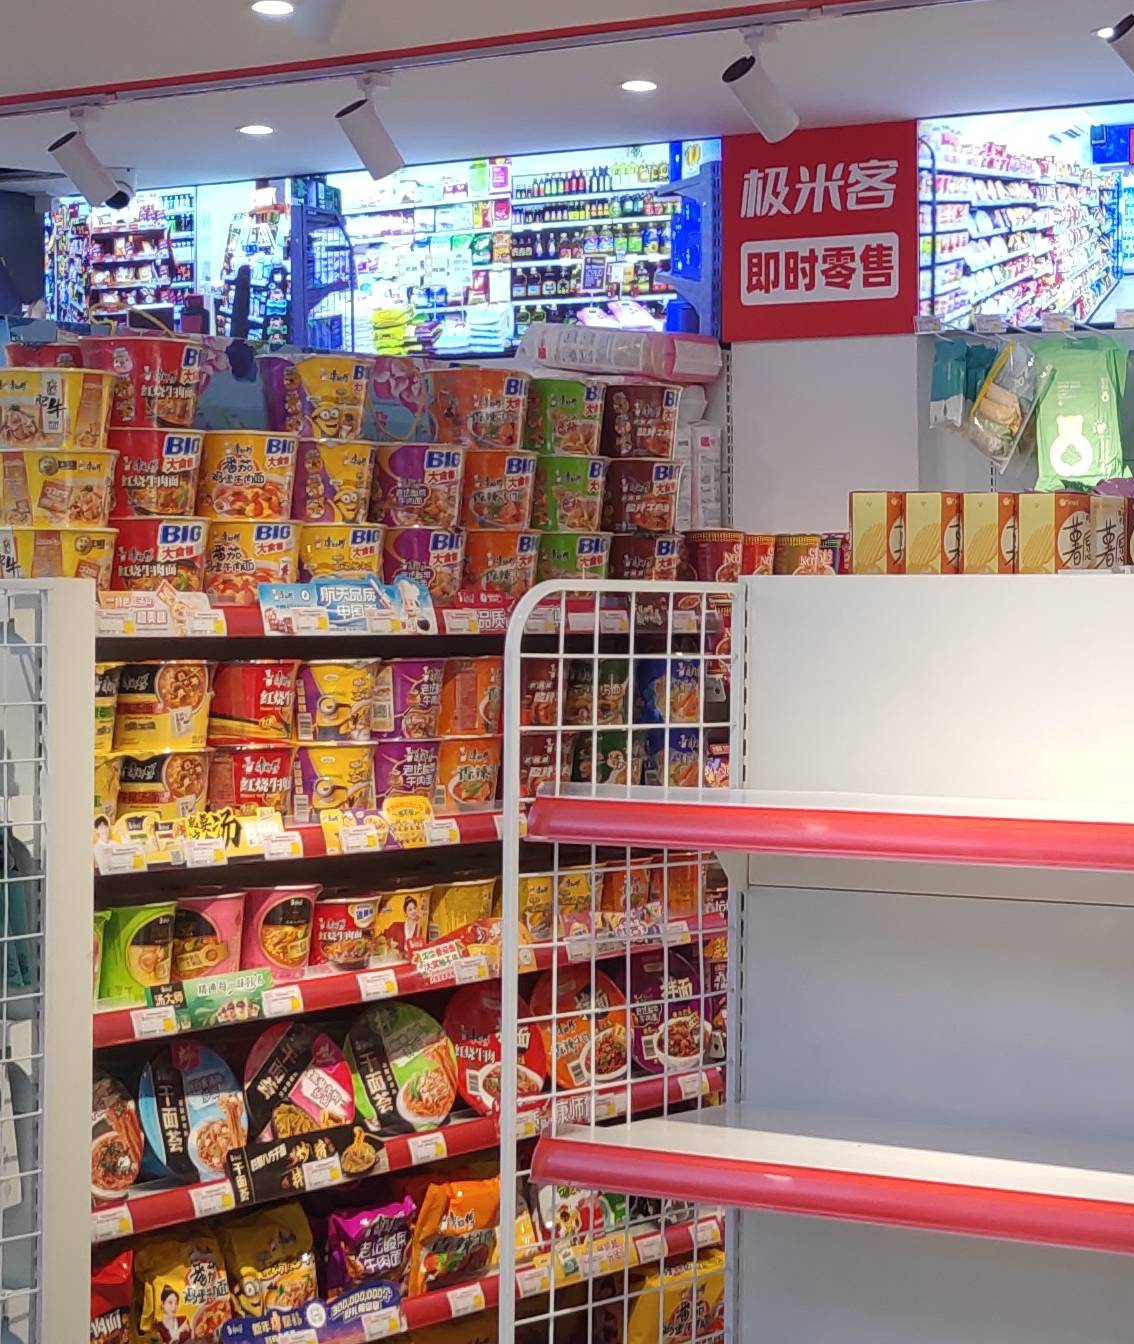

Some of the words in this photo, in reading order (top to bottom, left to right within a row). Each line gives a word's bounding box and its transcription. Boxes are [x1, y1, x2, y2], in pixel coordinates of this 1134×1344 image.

[740, 159, 899, 218] 极米客
[745, 243, 895, 295] 即时零售
[222, 456, 254, 473] 番茄
[425, 450, 460, 468] BIG
[121, 474, 180, 488] 红烧牛肉面
[255, 525, 291, 541] BIG
[351, 529, 380, 545] BIG
[118, 561, 177, 577] 红烧牛肉面
[154, 990, 184, 1006] 汤大师
